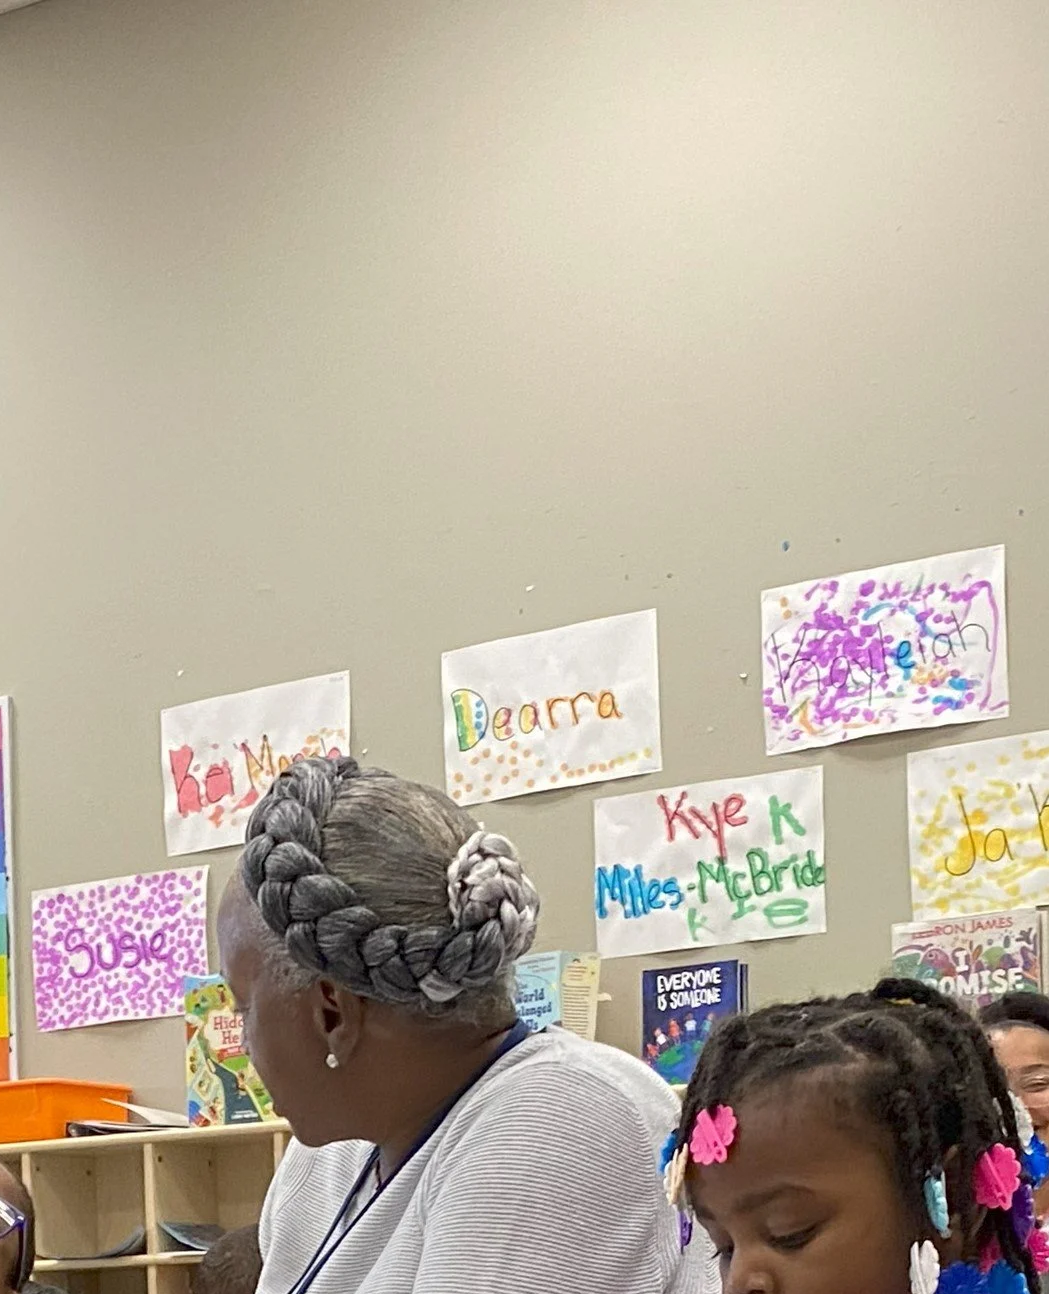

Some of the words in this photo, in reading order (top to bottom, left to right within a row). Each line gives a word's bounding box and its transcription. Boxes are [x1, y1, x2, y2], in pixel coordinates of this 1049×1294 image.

[450, 687, 625, 752] Dearra
[657, 790, 750, 863] Kye
[970, 916, 1014, 934] JAMES
[64, 926, 173, 979] Susie
[955, 950, 970, 973] I
[656, 966, 722, 994] EVERYONE
[657, 994, 668, 1012] IS
[670, 987, 722, 1009] SOMEONE
